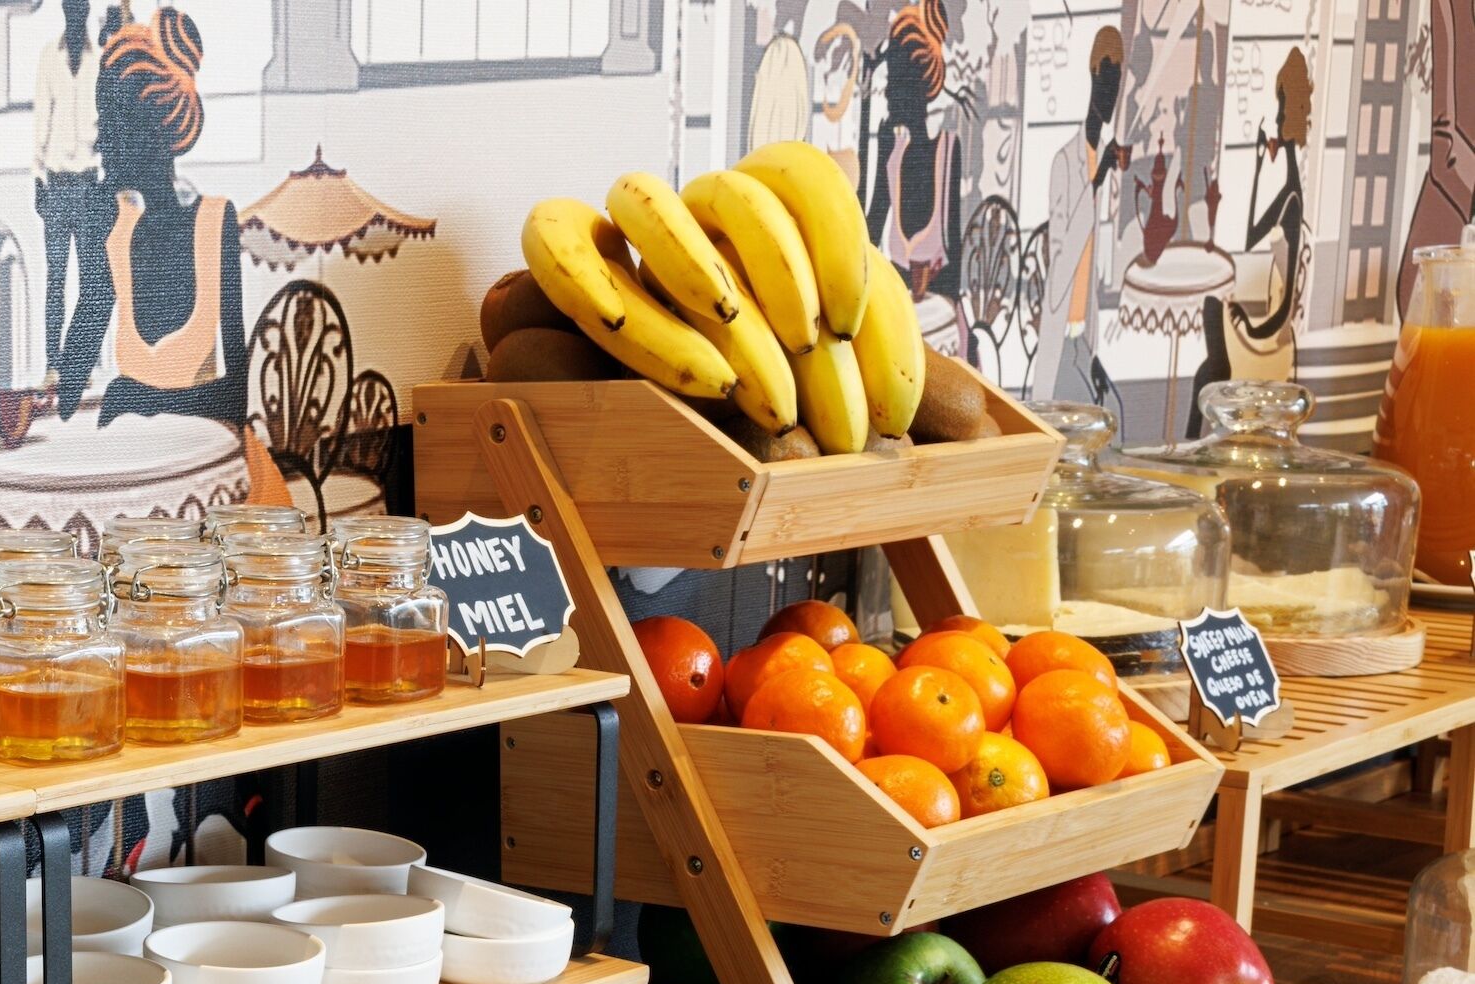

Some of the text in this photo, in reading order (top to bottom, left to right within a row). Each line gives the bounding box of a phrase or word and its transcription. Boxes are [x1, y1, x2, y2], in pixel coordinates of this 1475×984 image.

[431, 535, 526, 580] HONEY
[458, 592, 545, 635] MIEL
[1189, 629, 1225, 658] SHEEP
[1211, 647, 1254, 674] CHEESE
[1245, 668, 1265, 687] DE
[1235, 689, 1271, 710] OVEJA
